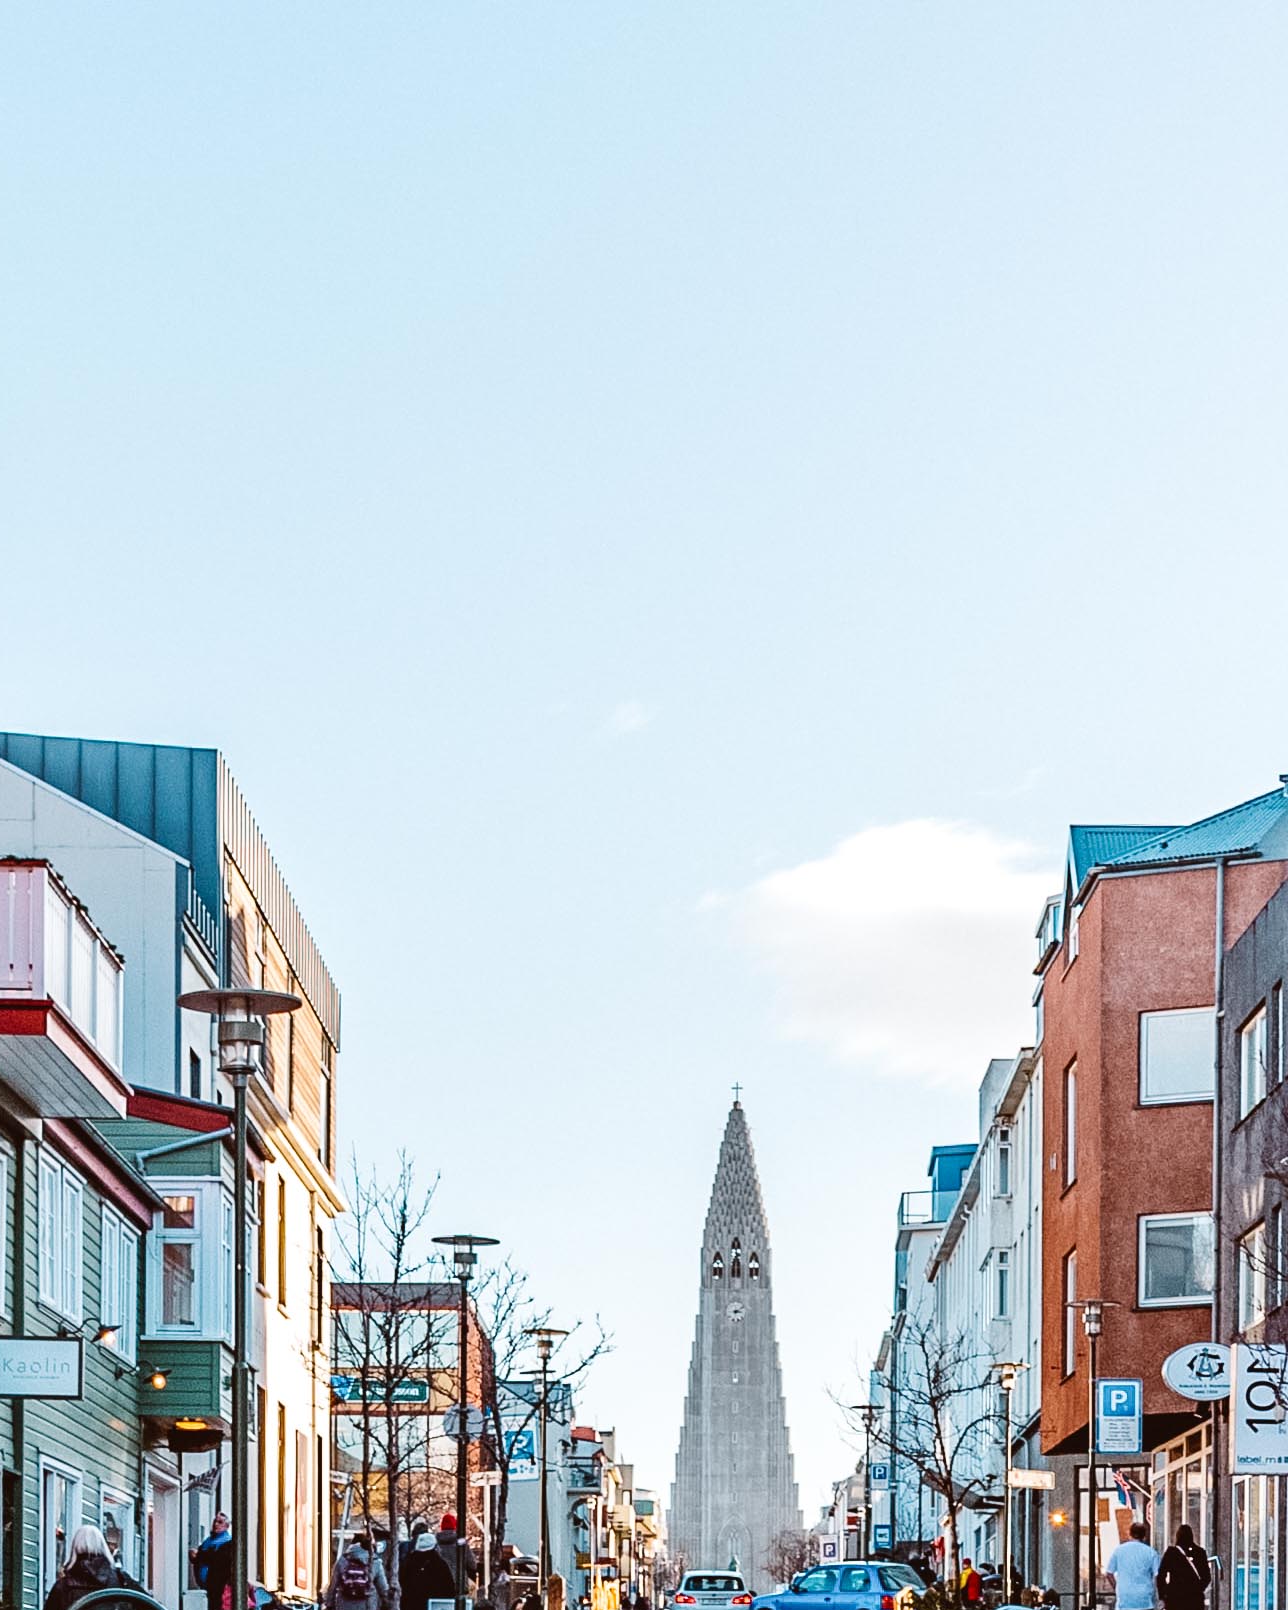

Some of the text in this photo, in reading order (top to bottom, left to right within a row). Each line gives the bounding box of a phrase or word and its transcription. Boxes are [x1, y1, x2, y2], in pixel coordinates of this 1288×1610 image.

[2, 1357, 70, 1374] Kaolin
[1110, 1390, 1128, 1411] P
[875, 1467, 885, 1479] P
[825, 1545, 834, 1556] P
